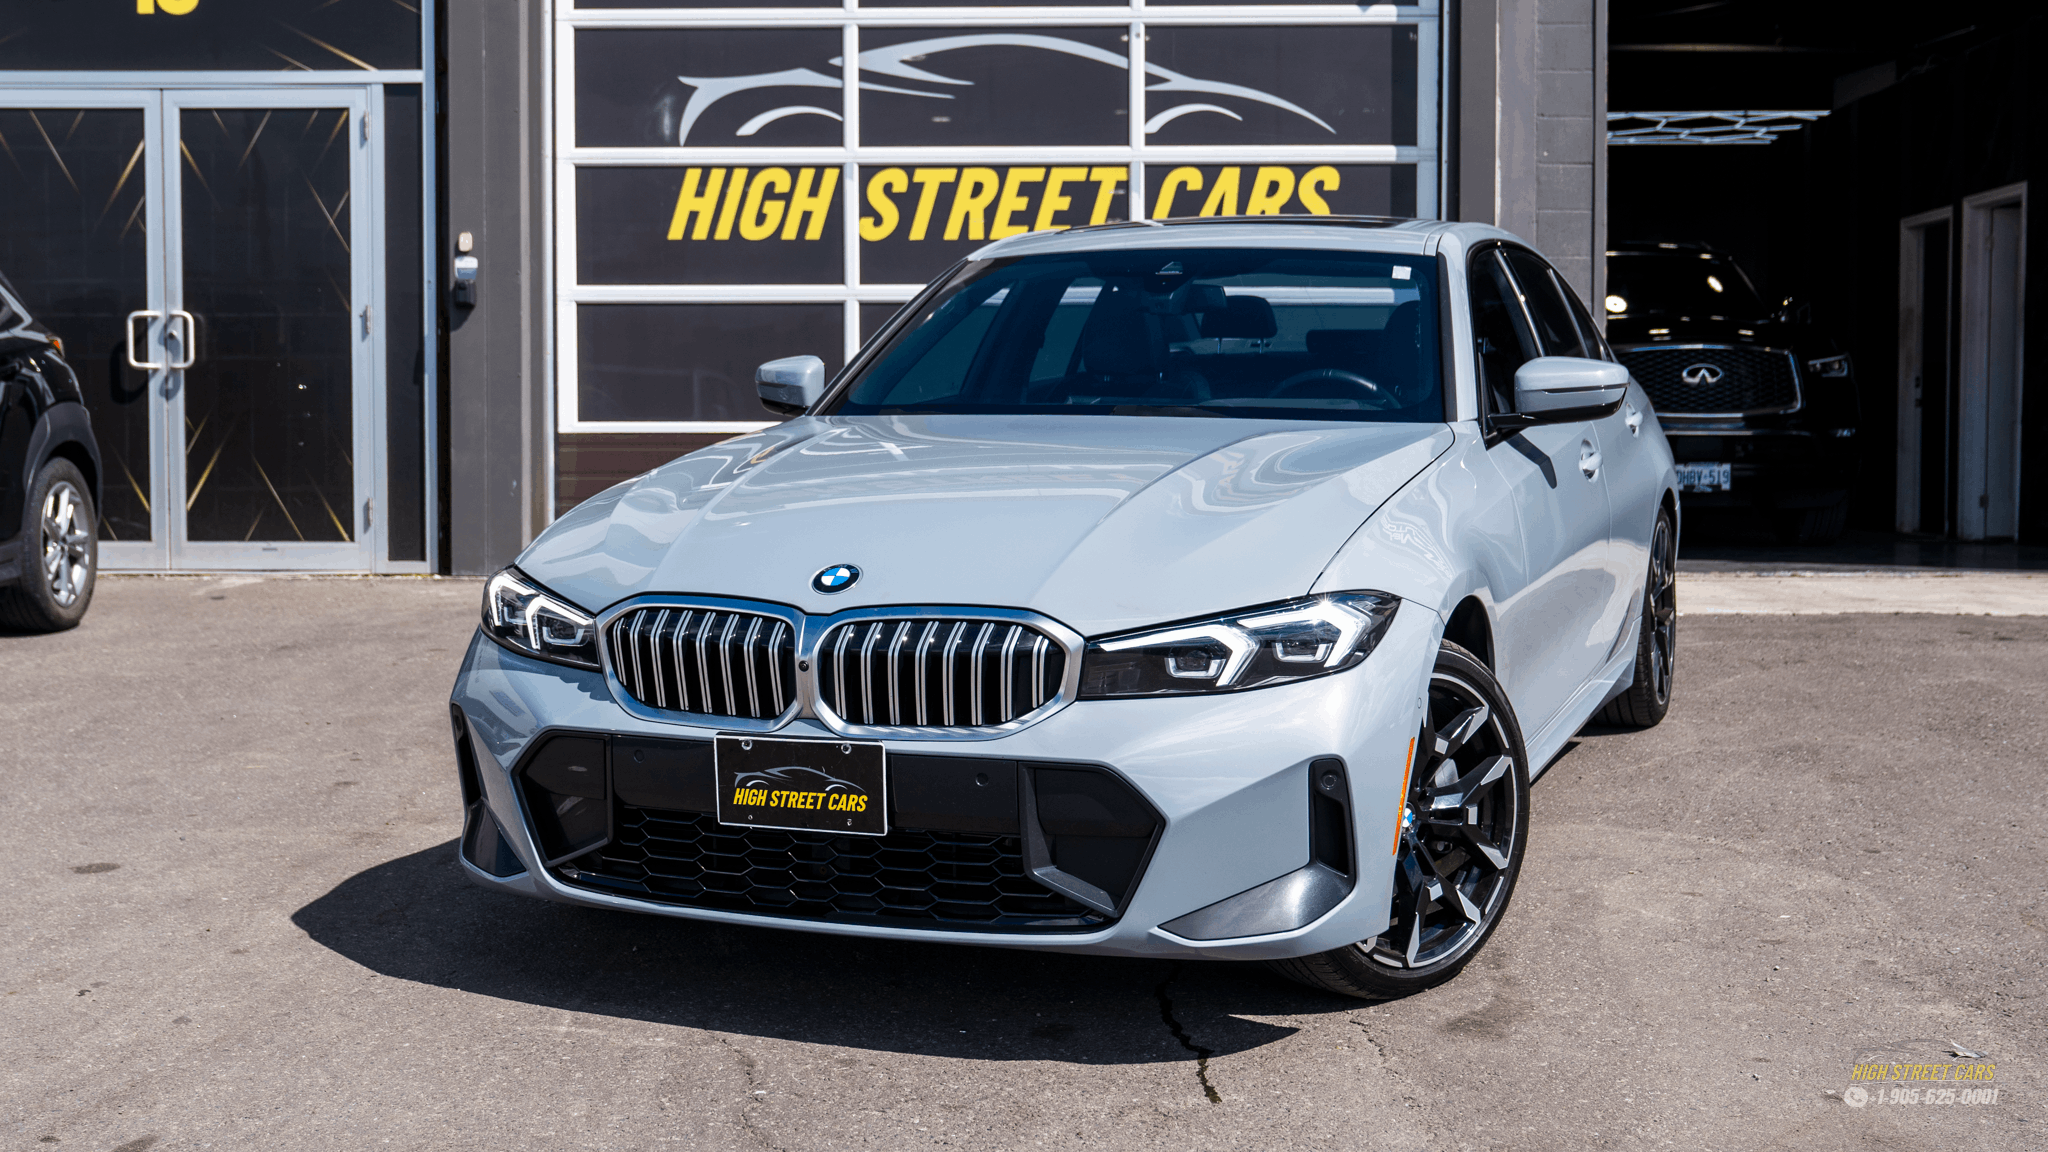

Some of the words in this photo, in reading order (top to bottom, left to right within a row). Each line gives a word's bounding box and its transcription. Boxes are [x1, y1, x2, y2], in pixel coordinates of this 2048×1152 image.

[667, 167, 840, 240] HIGH
[859, 167, 1129, 241] STREET
[1152, 166, 1340, 219] CARS
[733, 788, 768, 806] HIGH
[769, 790, 826, 810] STREET
[827, 793, 868, 812] CARS
